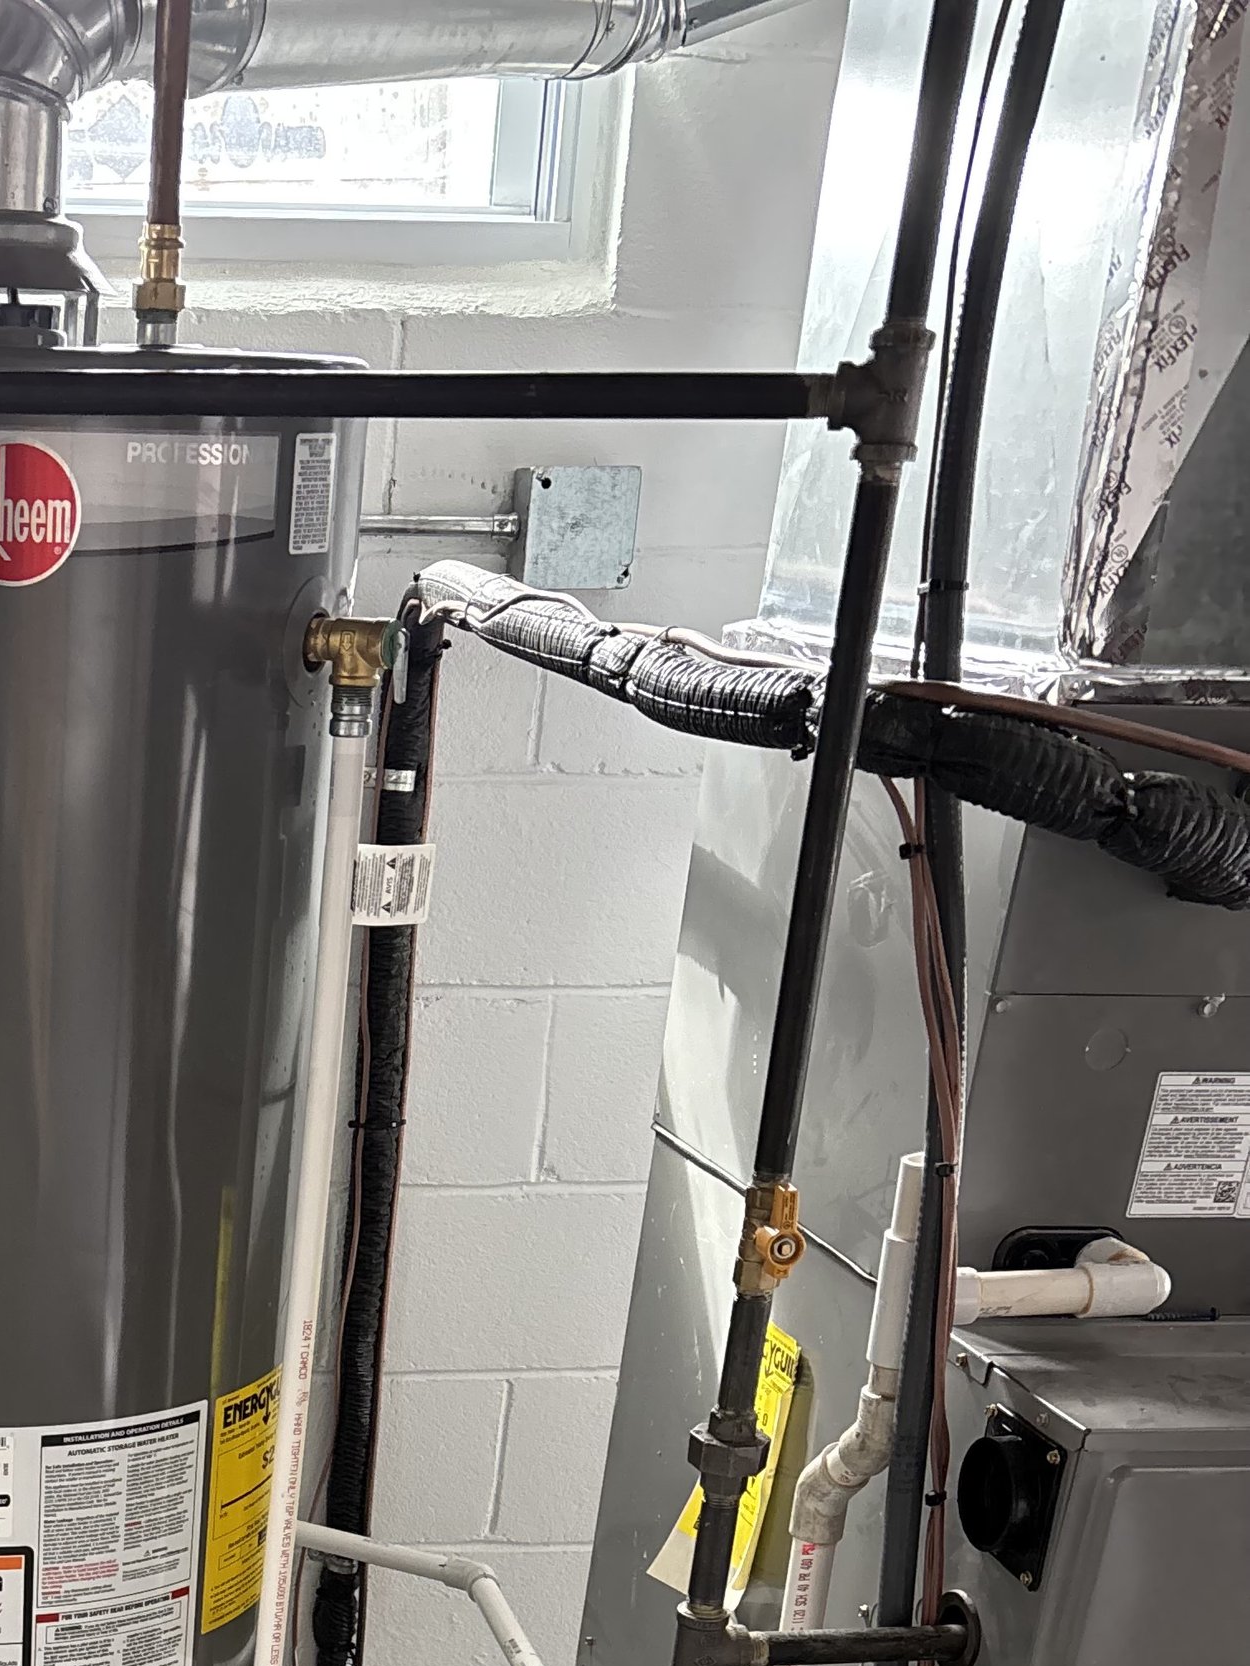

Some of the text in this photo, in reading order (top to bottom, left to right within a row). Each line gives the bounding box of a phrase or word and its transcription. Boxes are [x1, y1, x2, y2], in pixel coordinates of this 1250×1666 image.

[298, 1352, 310, 1380] CAMCO
[63, 1418, 184, 1442] INSTALLATION AND OPERATION DETAILS
[67, 1433, 180, 1456] AUTOMATIC STORAGE WATER HEATER
